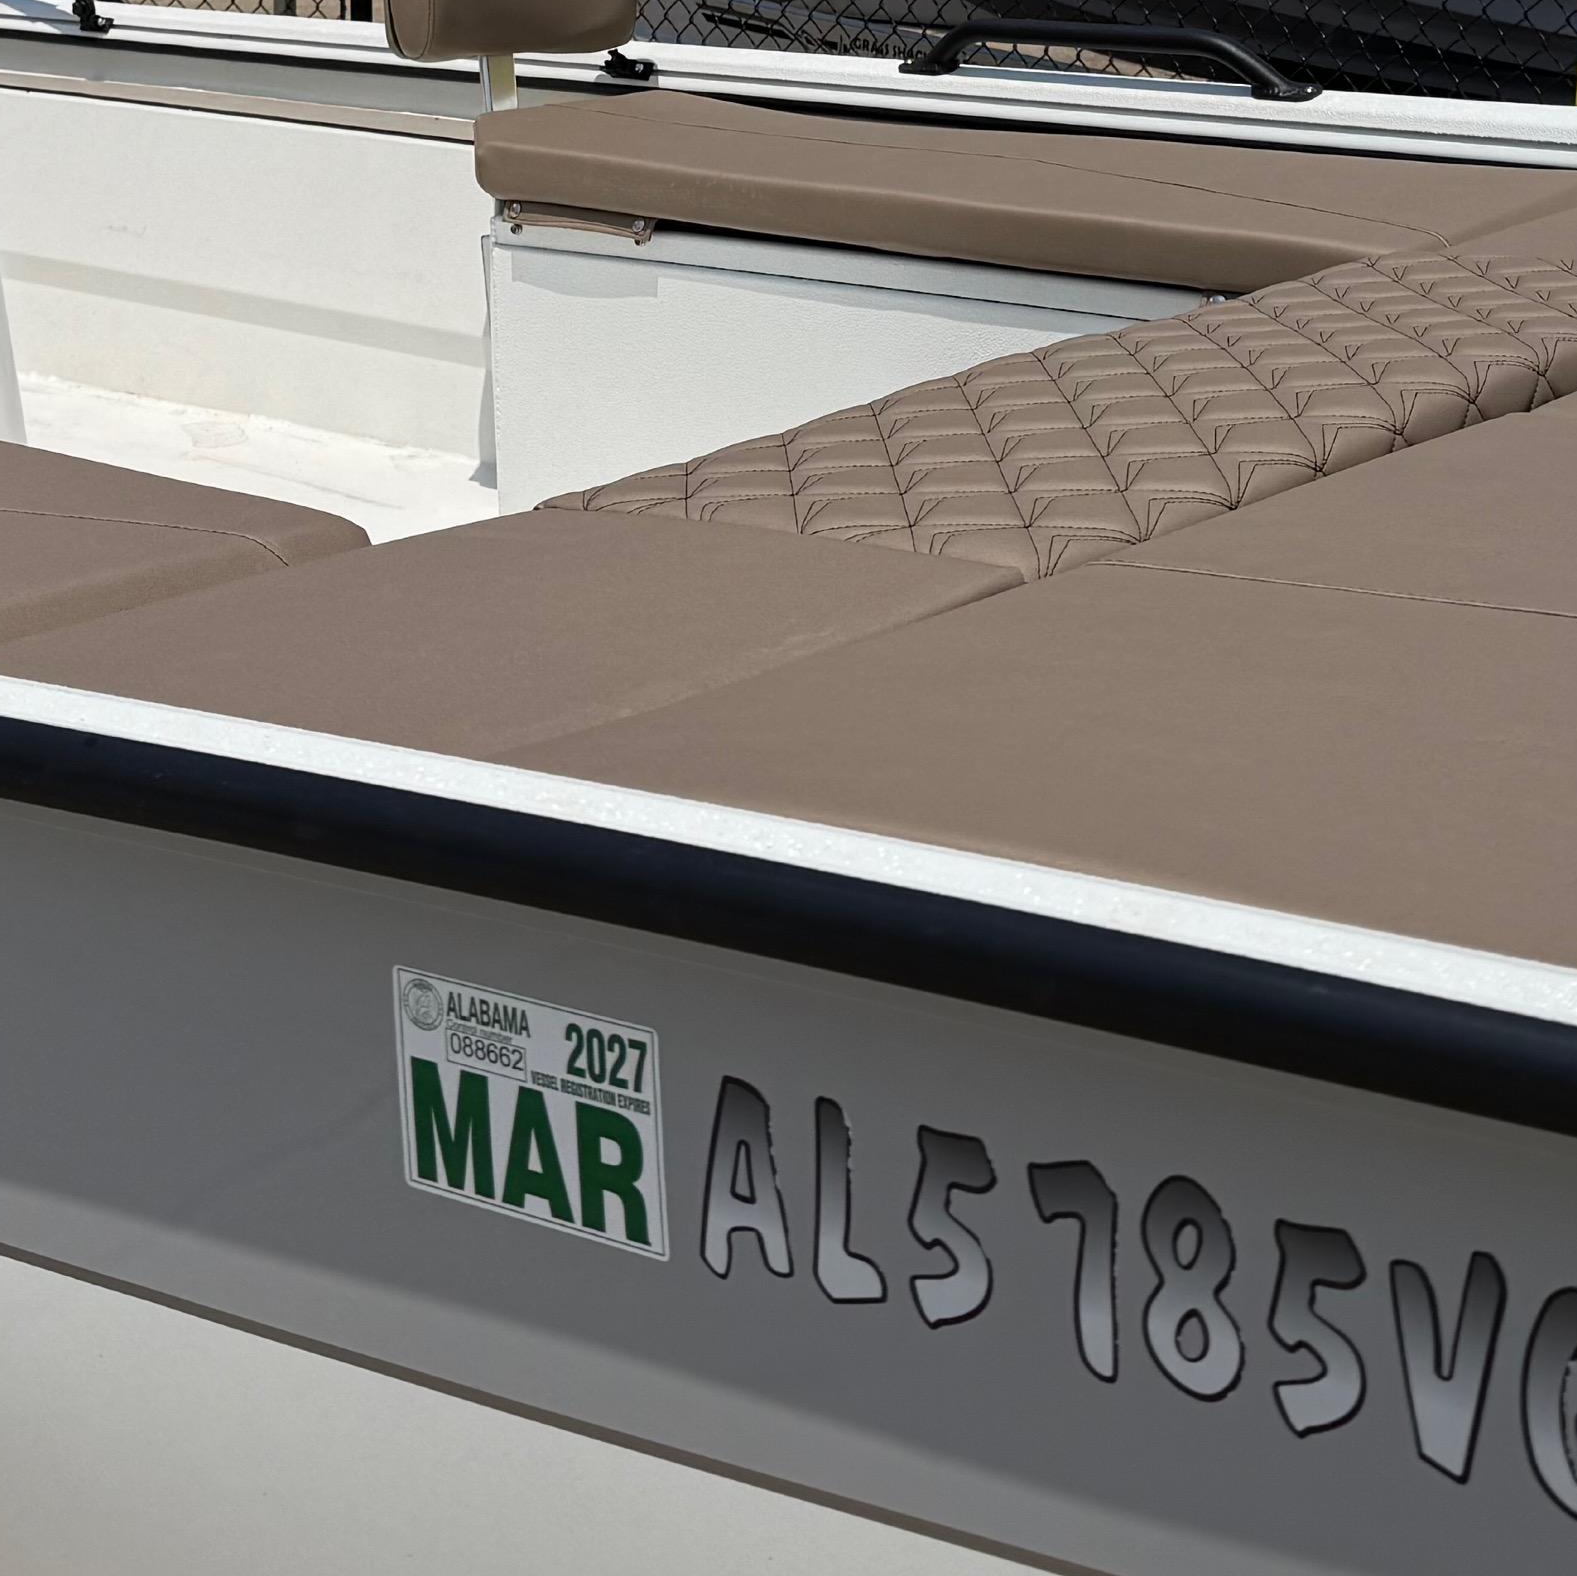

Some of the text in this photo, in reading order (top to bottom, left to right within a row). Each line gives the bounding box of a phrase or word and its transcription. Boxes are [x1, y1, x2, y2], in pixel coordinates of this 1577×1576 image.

[446, 991, 531, 1039] ALABAMA
[450, 1032, 524, 1072] 088662
[565, 1022, 648, 1094] 2027
[410, 1055, 653, 1247] MAR
